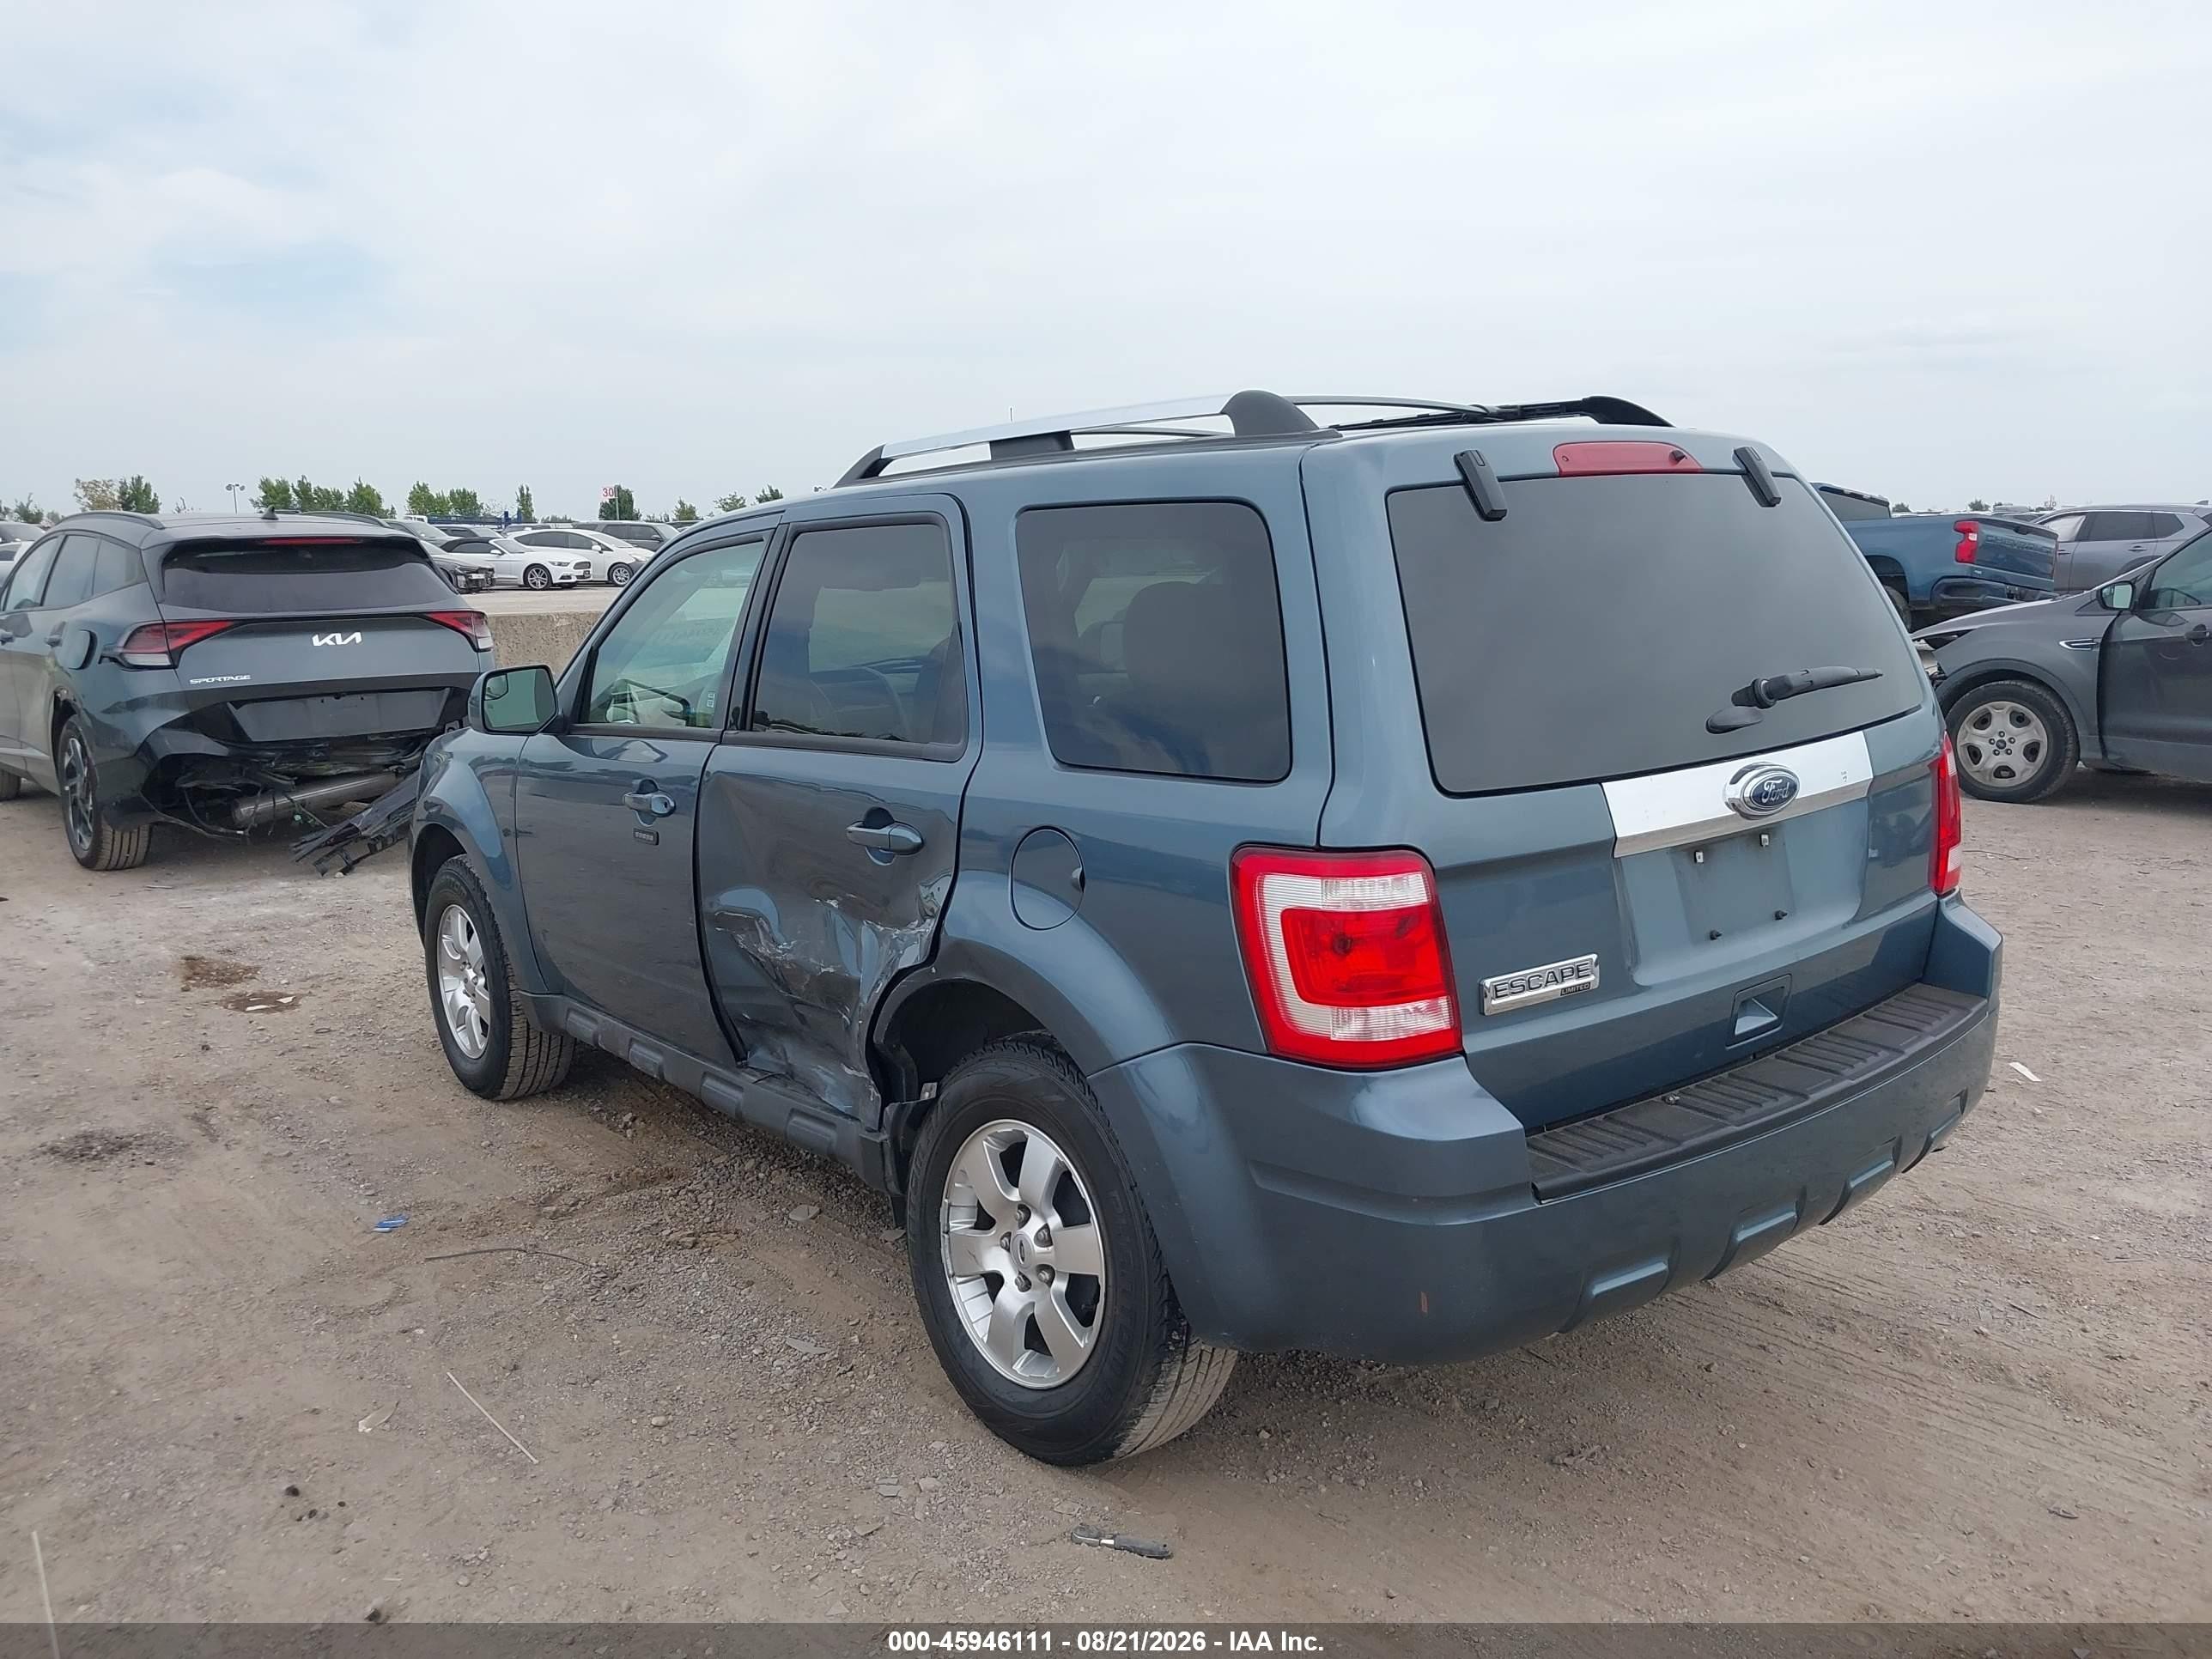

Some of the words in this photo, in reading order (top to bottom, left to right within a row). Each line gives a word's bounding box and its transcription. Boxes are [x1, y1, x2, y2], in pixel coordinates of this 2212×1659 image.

[602, 487, 614, 497] 30
[312, 632, 362, 647] KIA
[189, 674, 252, 684] SPORTAGE
[1761, 778, 1791, 804] Ford
[1494, 962, 1590, 999] ESCAPE
[1561, 983, 1589, 995] LIMITED
